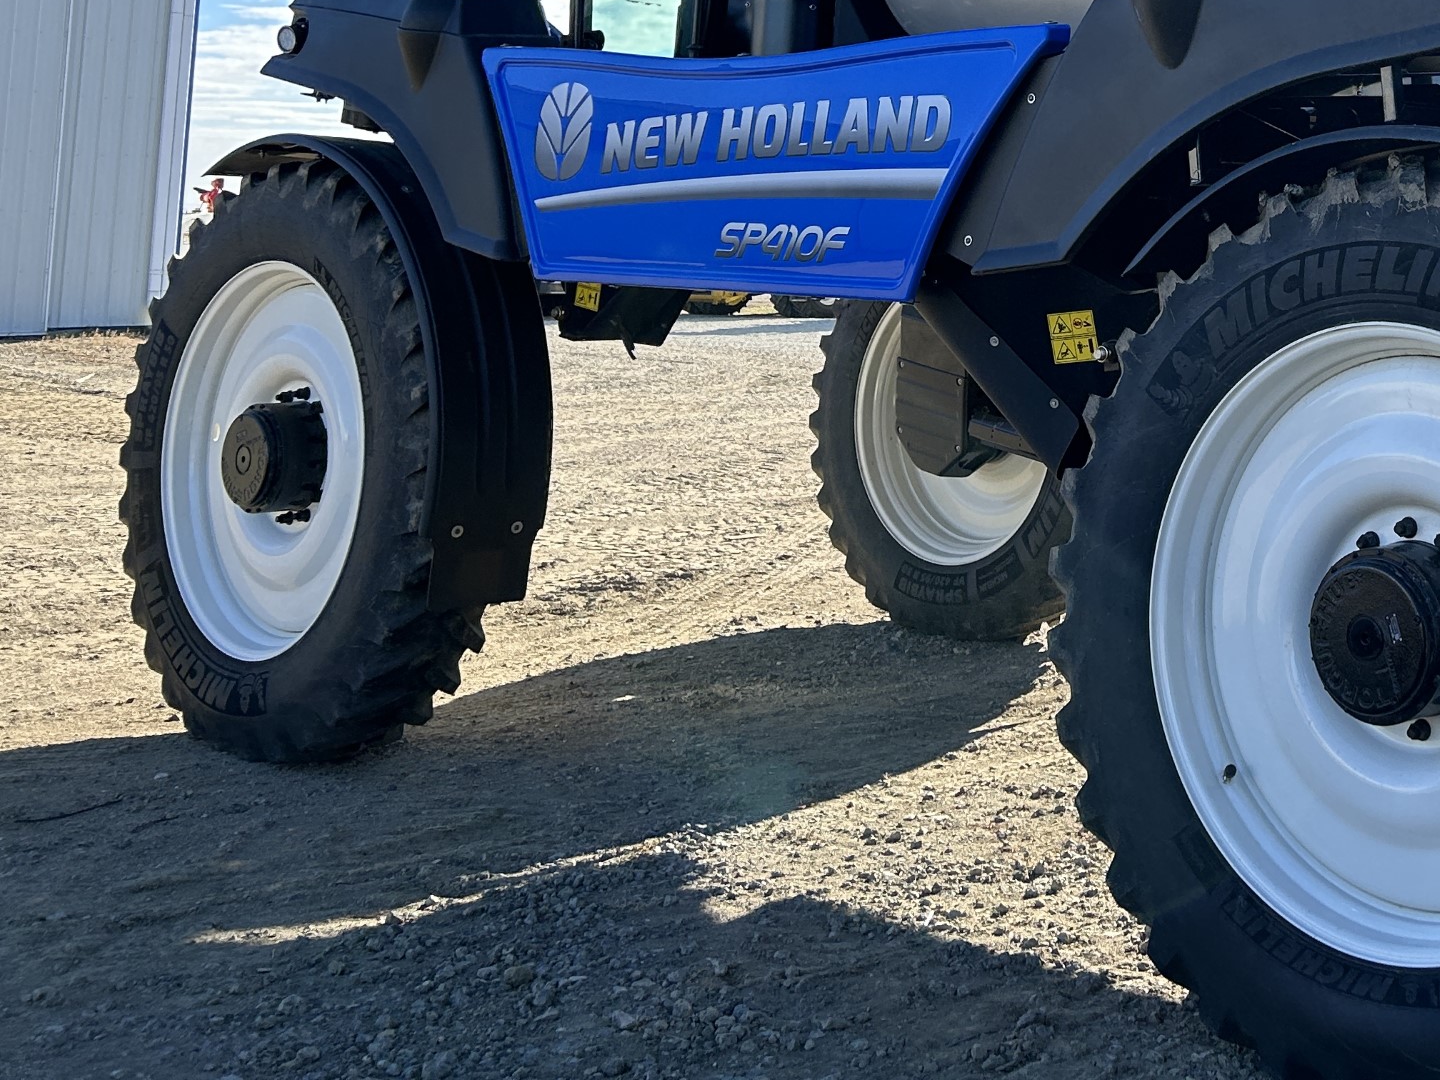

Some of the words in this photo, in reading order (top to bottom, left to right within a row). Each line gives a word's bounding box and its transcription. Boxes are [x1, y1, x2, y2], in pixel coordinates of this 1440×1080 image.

[600, 110, 709, 174] NEW
[716, 94, 951, 162] HOLLAND
[713, 221, 851, 263] SP410F
[139, 570, 237, 712] MICHELIN
[1220, 893, 1396, 1002] MICHELIN
